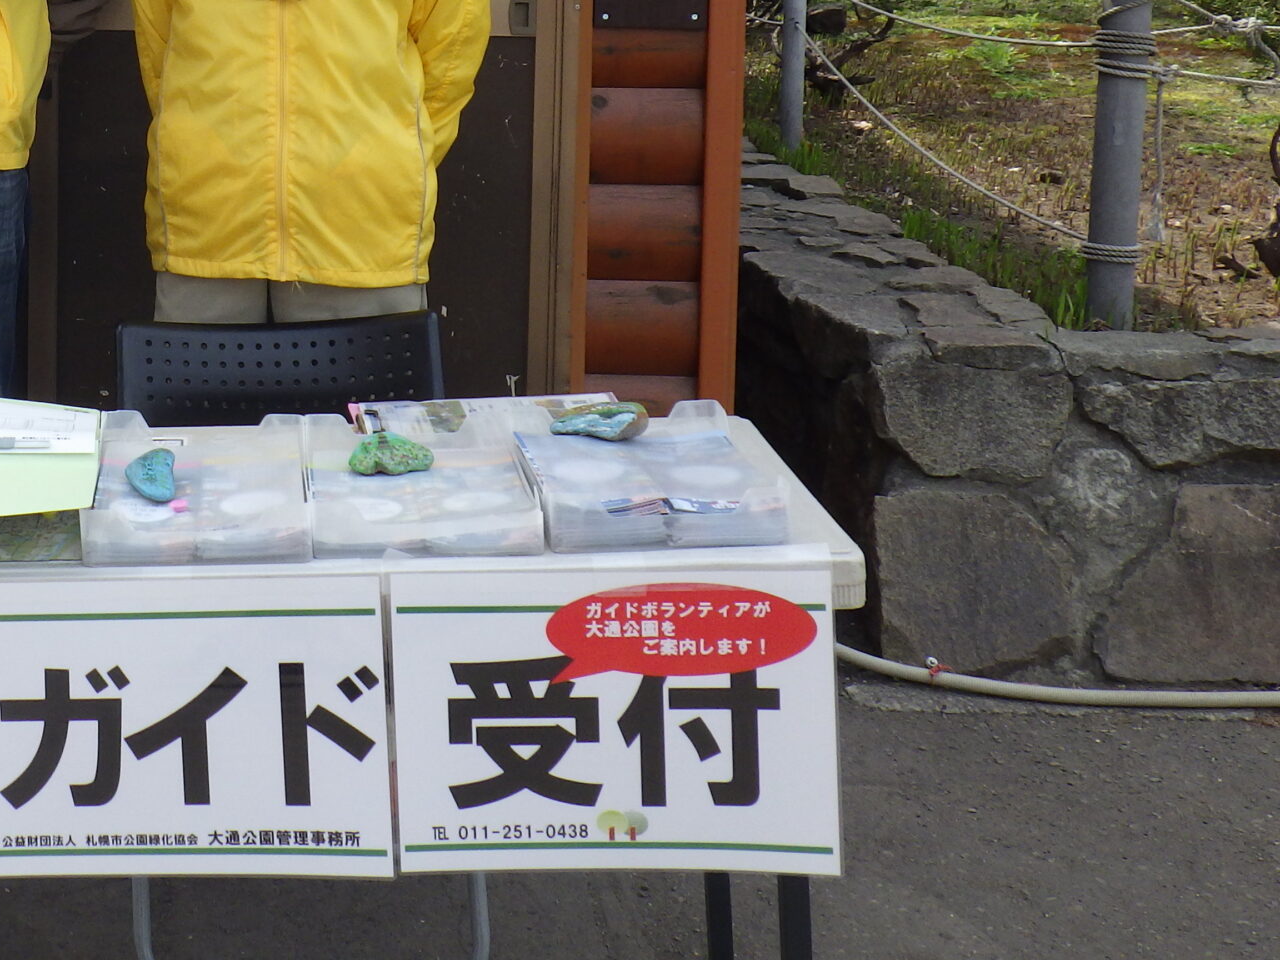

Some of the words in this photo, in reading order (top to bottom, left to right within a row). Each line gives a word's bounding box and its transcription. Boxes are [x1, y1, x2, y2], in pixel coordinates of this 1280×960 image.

[585, 601, 771, 619] ガイドボランティアが
[585, 620, 676, 638] 大通公園を
[641, 638, 767, 656] ご案内します！
[0, 662, 380, 810] ガイド
[447, 654, 781, 810] 受付
[2, 835, 77, 848] 公益財団法人
[86, 833, 199, 847] 札幌市公園緑化協会
[207, 829, 362, 847] 大通公園管理事務所
[432, 826, 449, 840] TEL
[458, 824, 589, 840] 011-251-0438
